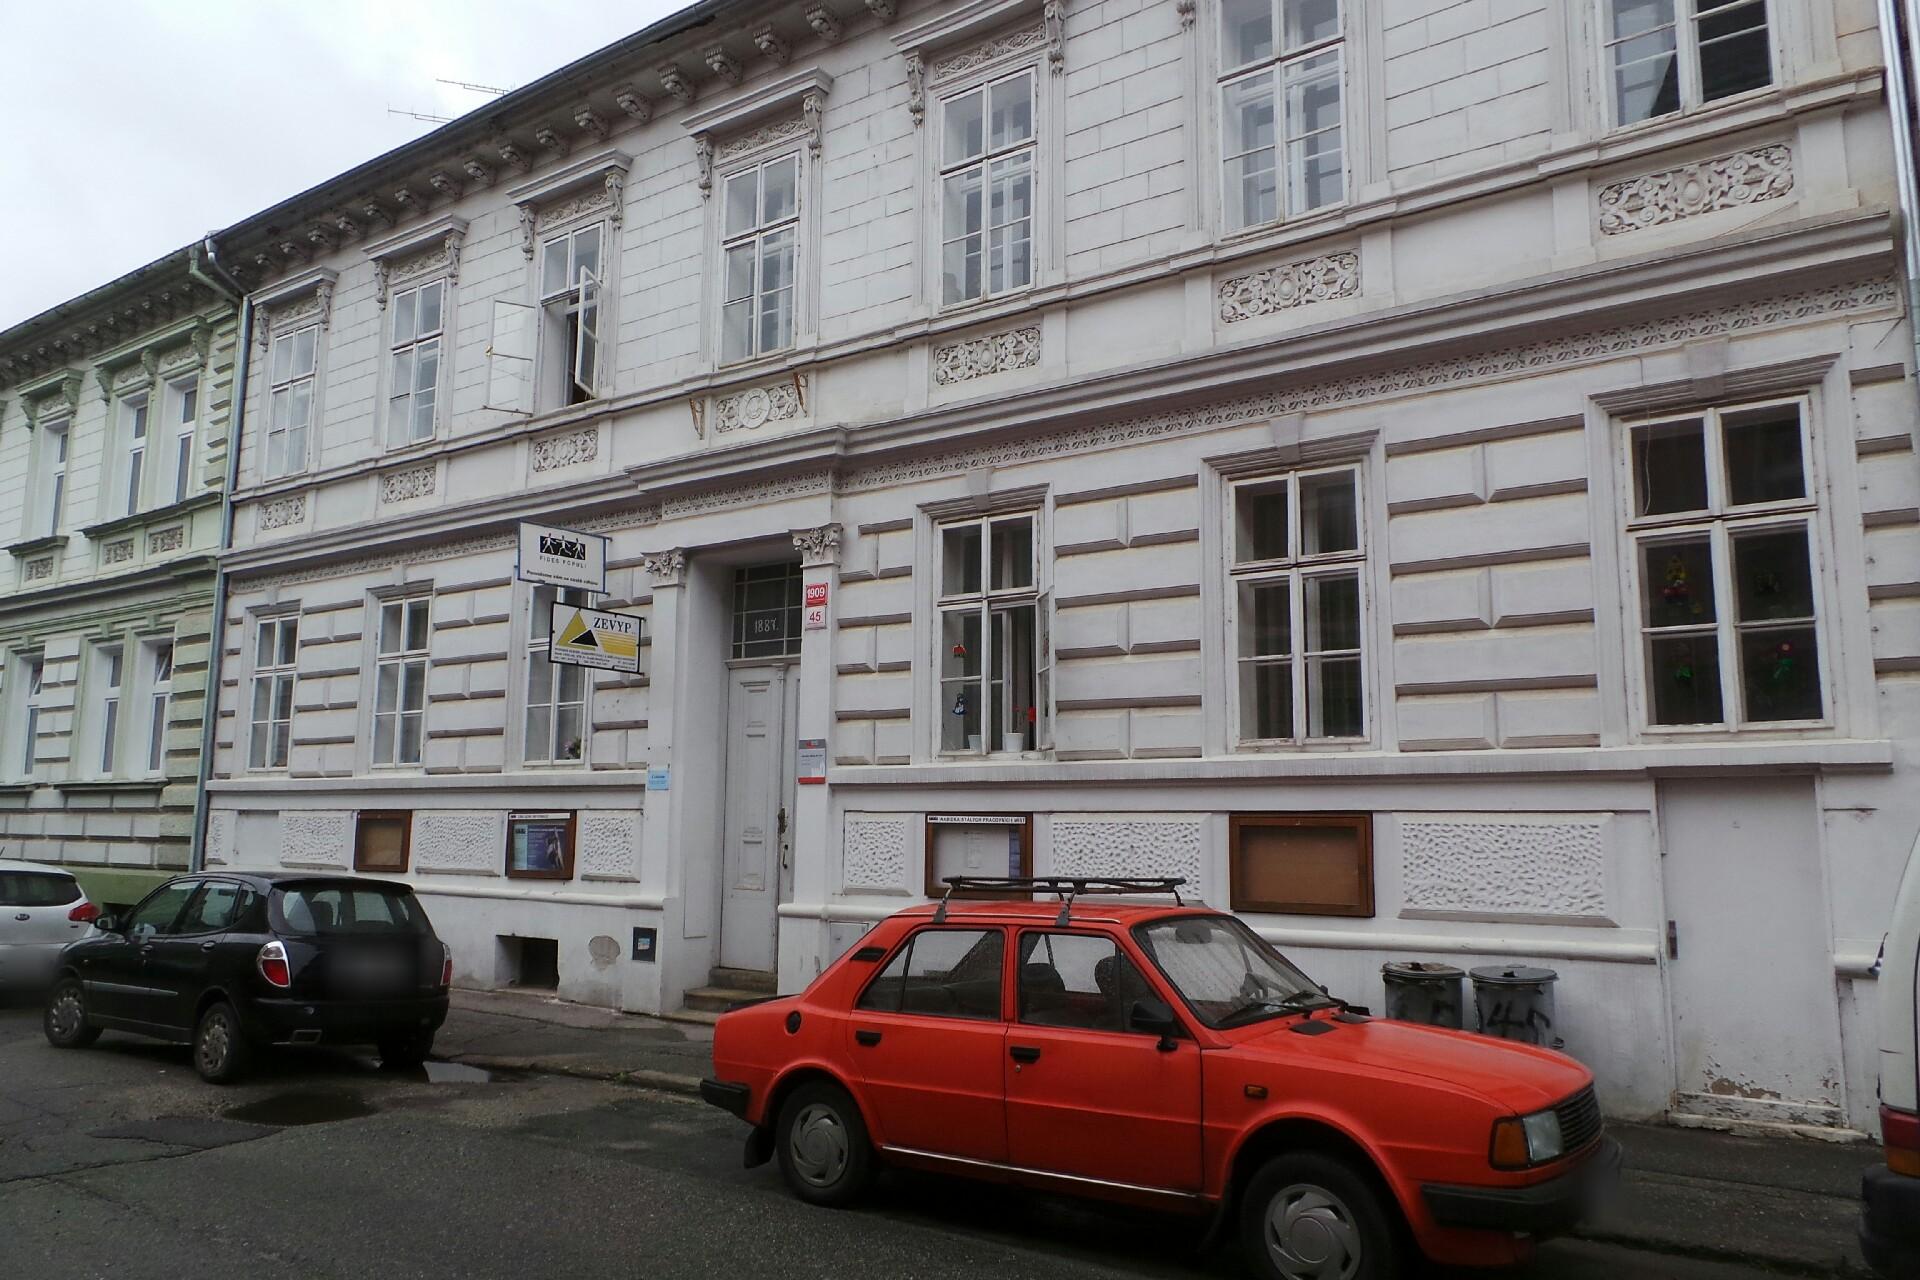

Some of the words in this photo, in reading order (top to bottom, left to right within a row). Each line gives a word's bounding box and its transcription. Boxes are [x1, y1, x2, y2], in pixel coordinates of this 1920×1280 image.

[540, 555, 560, 564] FIDES
[807, 587, 825, 599] 1909
[809, 611, 821, 622] 45
[593, 617, 632, 634] ZEVYP
